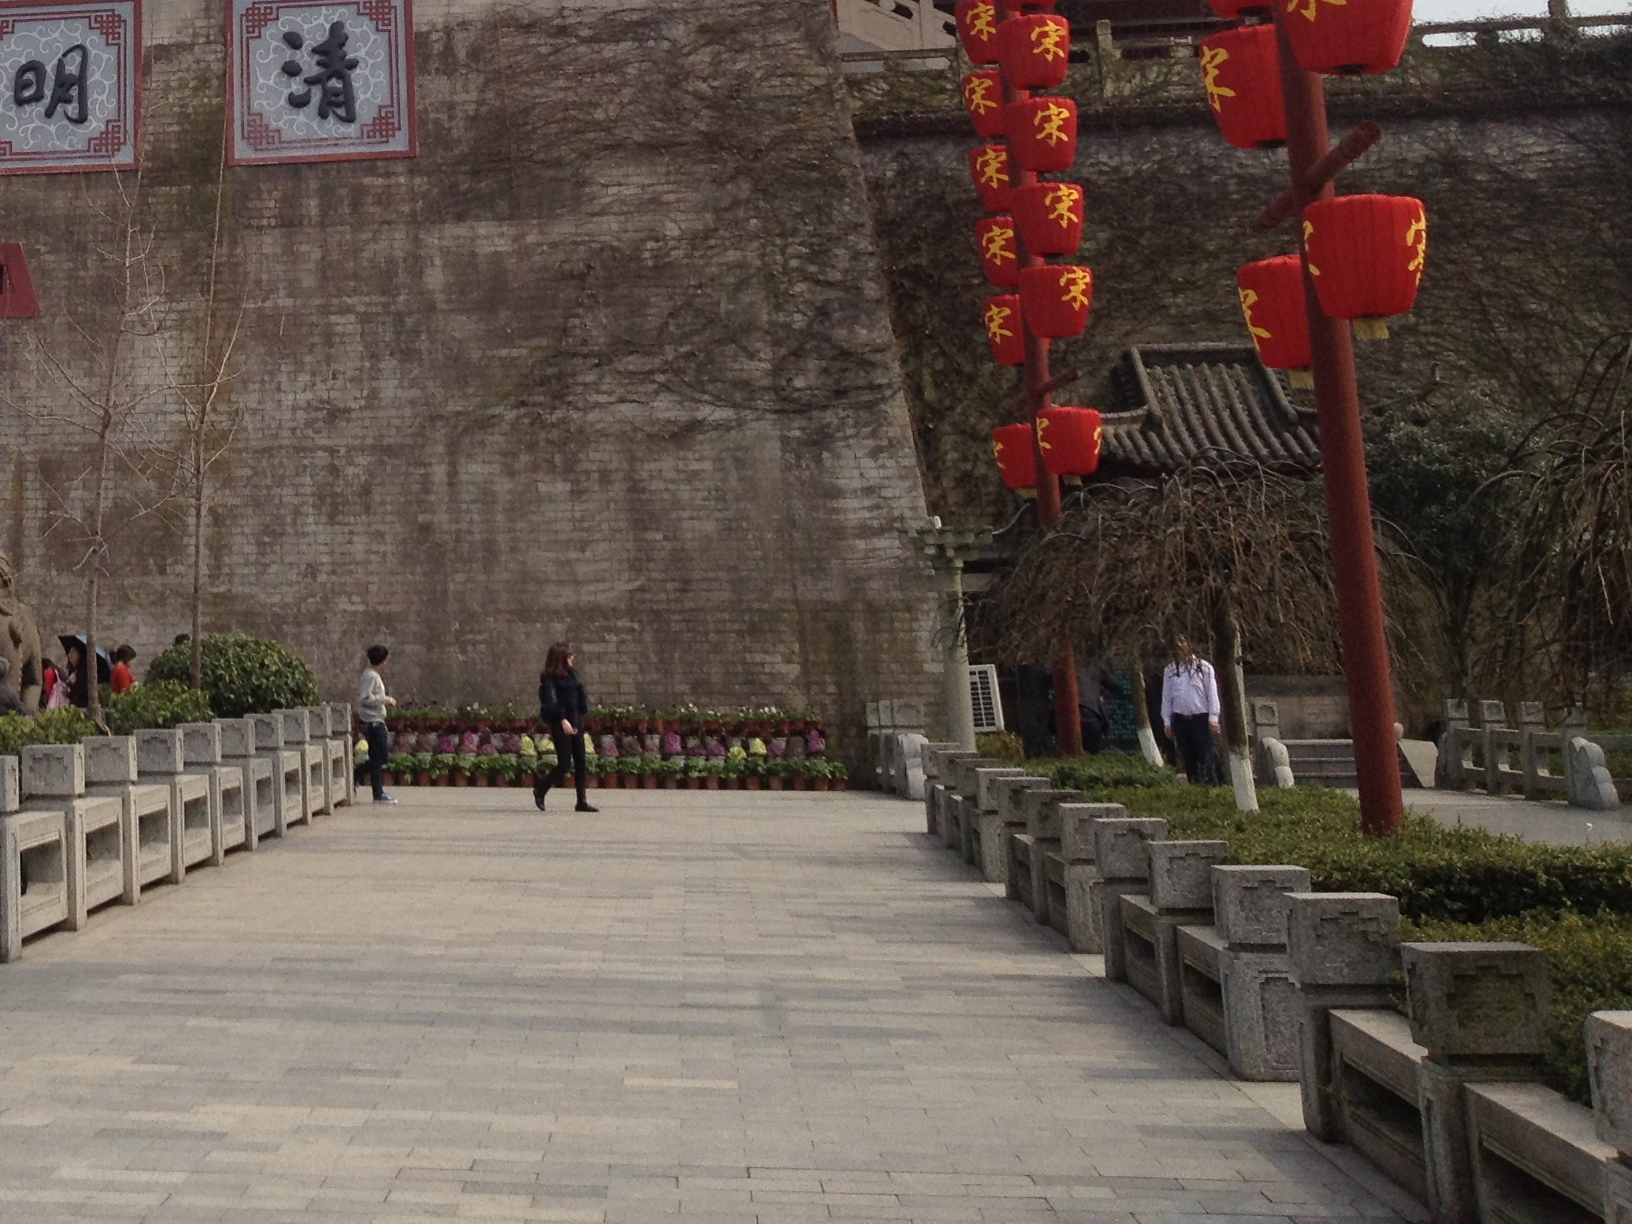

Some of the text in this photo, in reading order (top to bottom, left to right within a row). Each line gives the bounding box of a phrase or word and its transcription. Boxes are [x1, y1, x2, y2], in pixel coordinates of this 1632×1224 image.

[965, 2, 996, 41] 宋
[1030, 20, 1065, 61] 宋
[13, 43, 88, 124] 明
[280, 20, 358, 123] 清
[964, 77, 997, 114] 宋
[1033, 102, 1068, 146] 宋
[975, 148, 1008, 188] 宋
[1044, 184, 1079, 227] 宋
[982, 225, 1014, 264] 宋
[1059, 266, 1090, 309] 宋
[984, 304, 1012, 342] 宋
